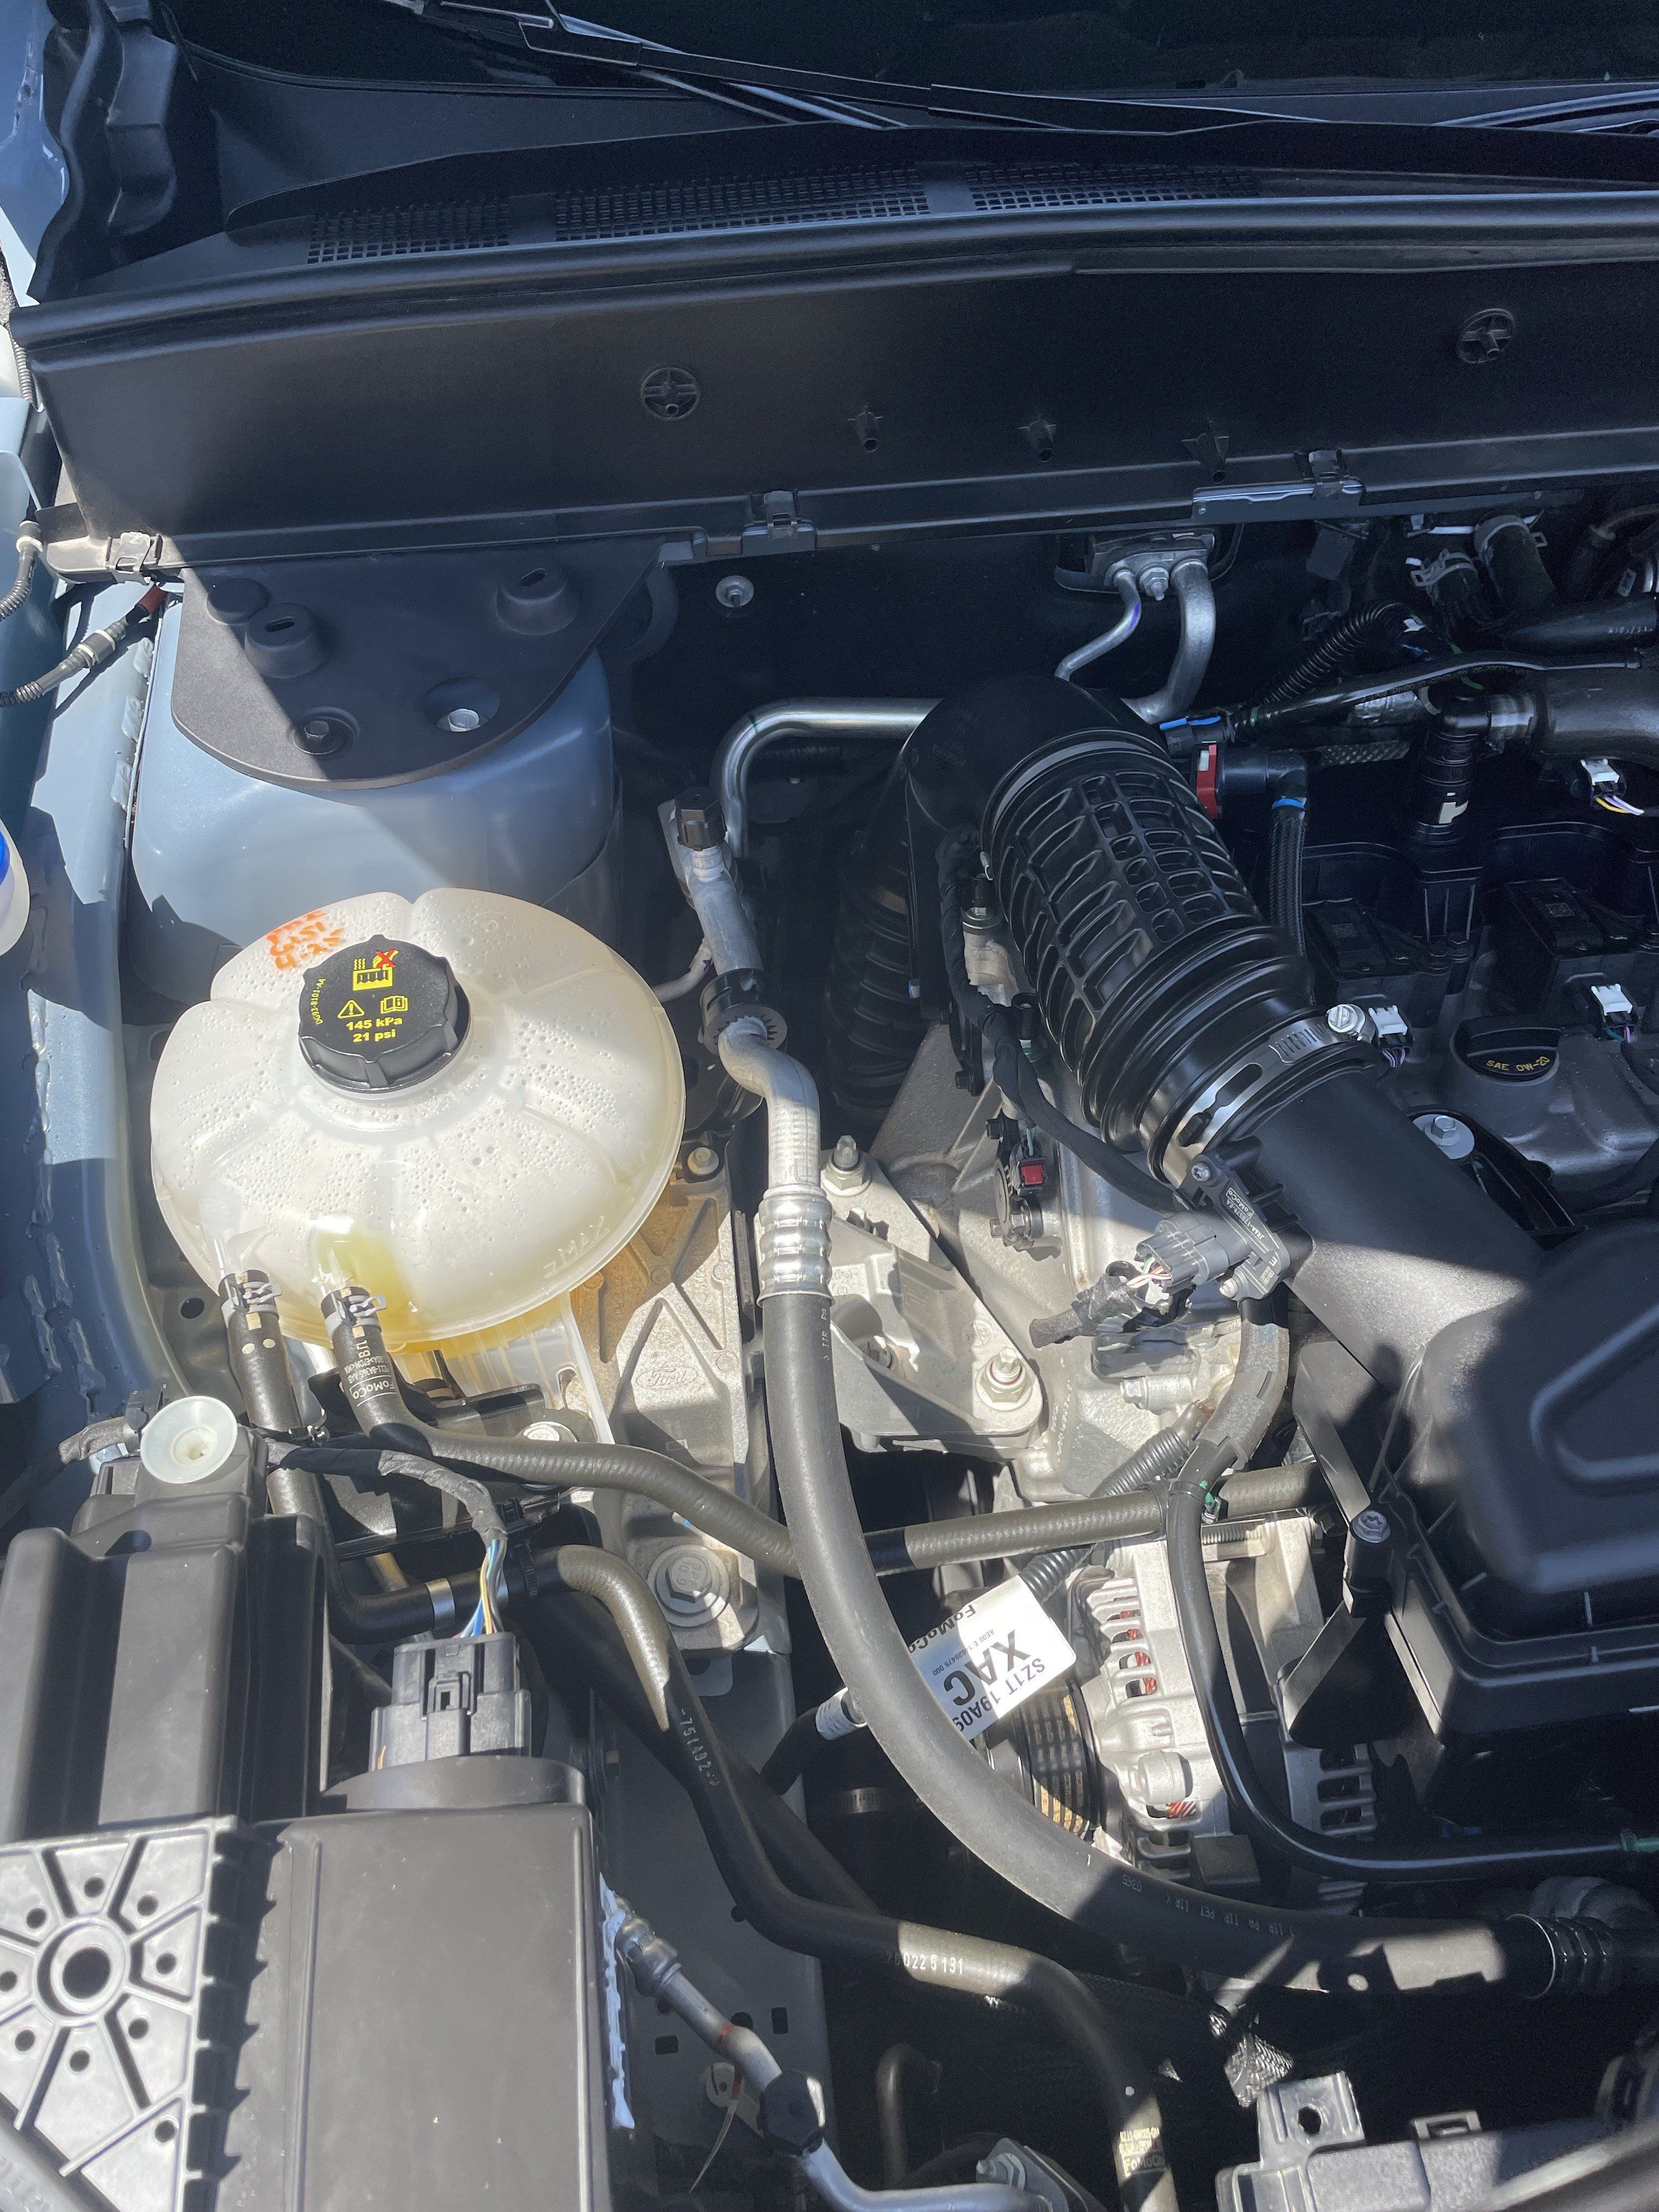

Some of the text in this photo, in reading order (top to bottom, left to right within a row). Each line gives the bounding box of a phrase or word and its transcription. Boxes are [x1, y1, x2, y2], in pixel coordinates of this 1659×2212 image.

[346, 1017, 403, 1031] 145 kPa
[353, 1029, 397, 1042] 21 psi
[1486, 1056, 1550, 1071] SAE 0W-20
[1227, 1189, 1253, 1217] FoMoCo
[353, 1380, 395, 1400] FoMoCo
[908, 1604, 977, 1654] FoMoCo
[944, 1629, 1032, 1706] XAC
[1008, 1657, 1046, 1695] SZ1T
